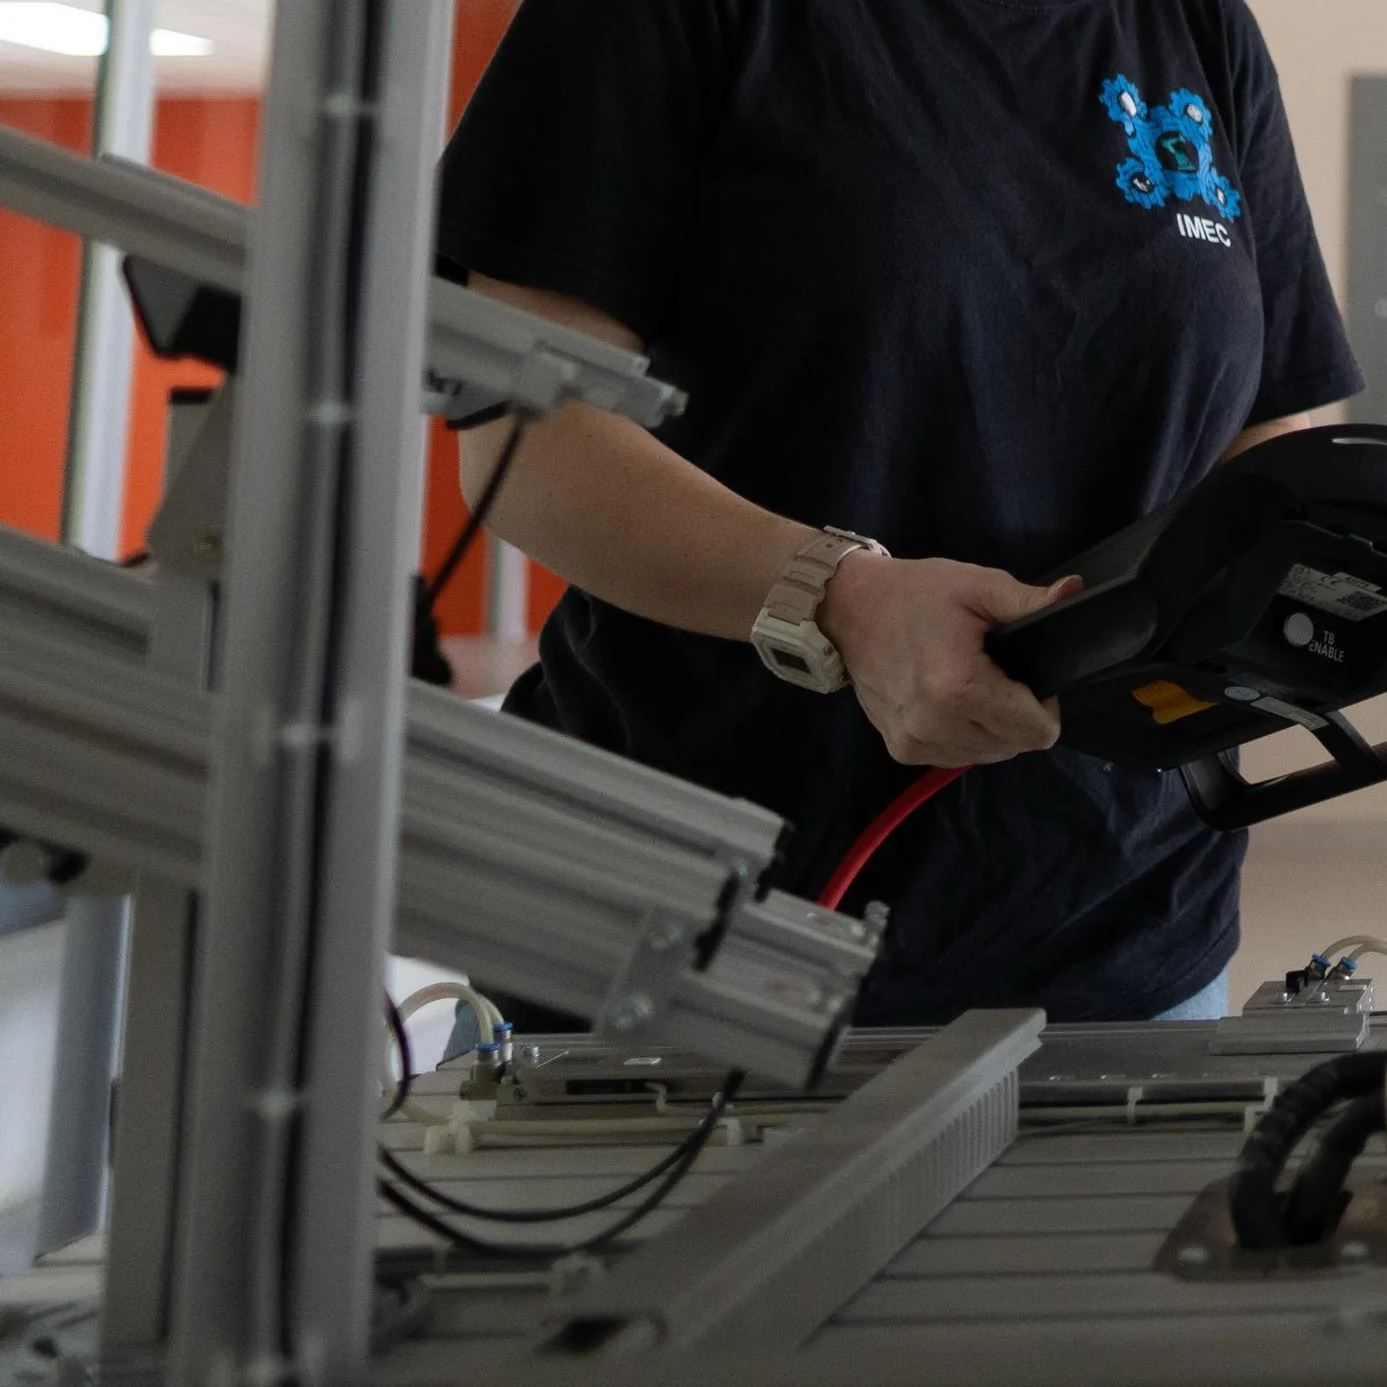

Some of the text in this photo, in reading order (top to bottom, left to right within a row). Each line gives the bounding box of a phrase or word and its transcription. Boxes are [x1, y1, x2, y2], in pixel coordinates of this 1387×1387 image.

[1176, 213, 1232, 248] IMEC
[1323, 630, 1335, 646] TB
[1308, 639, 1345, 663] ENABLE
